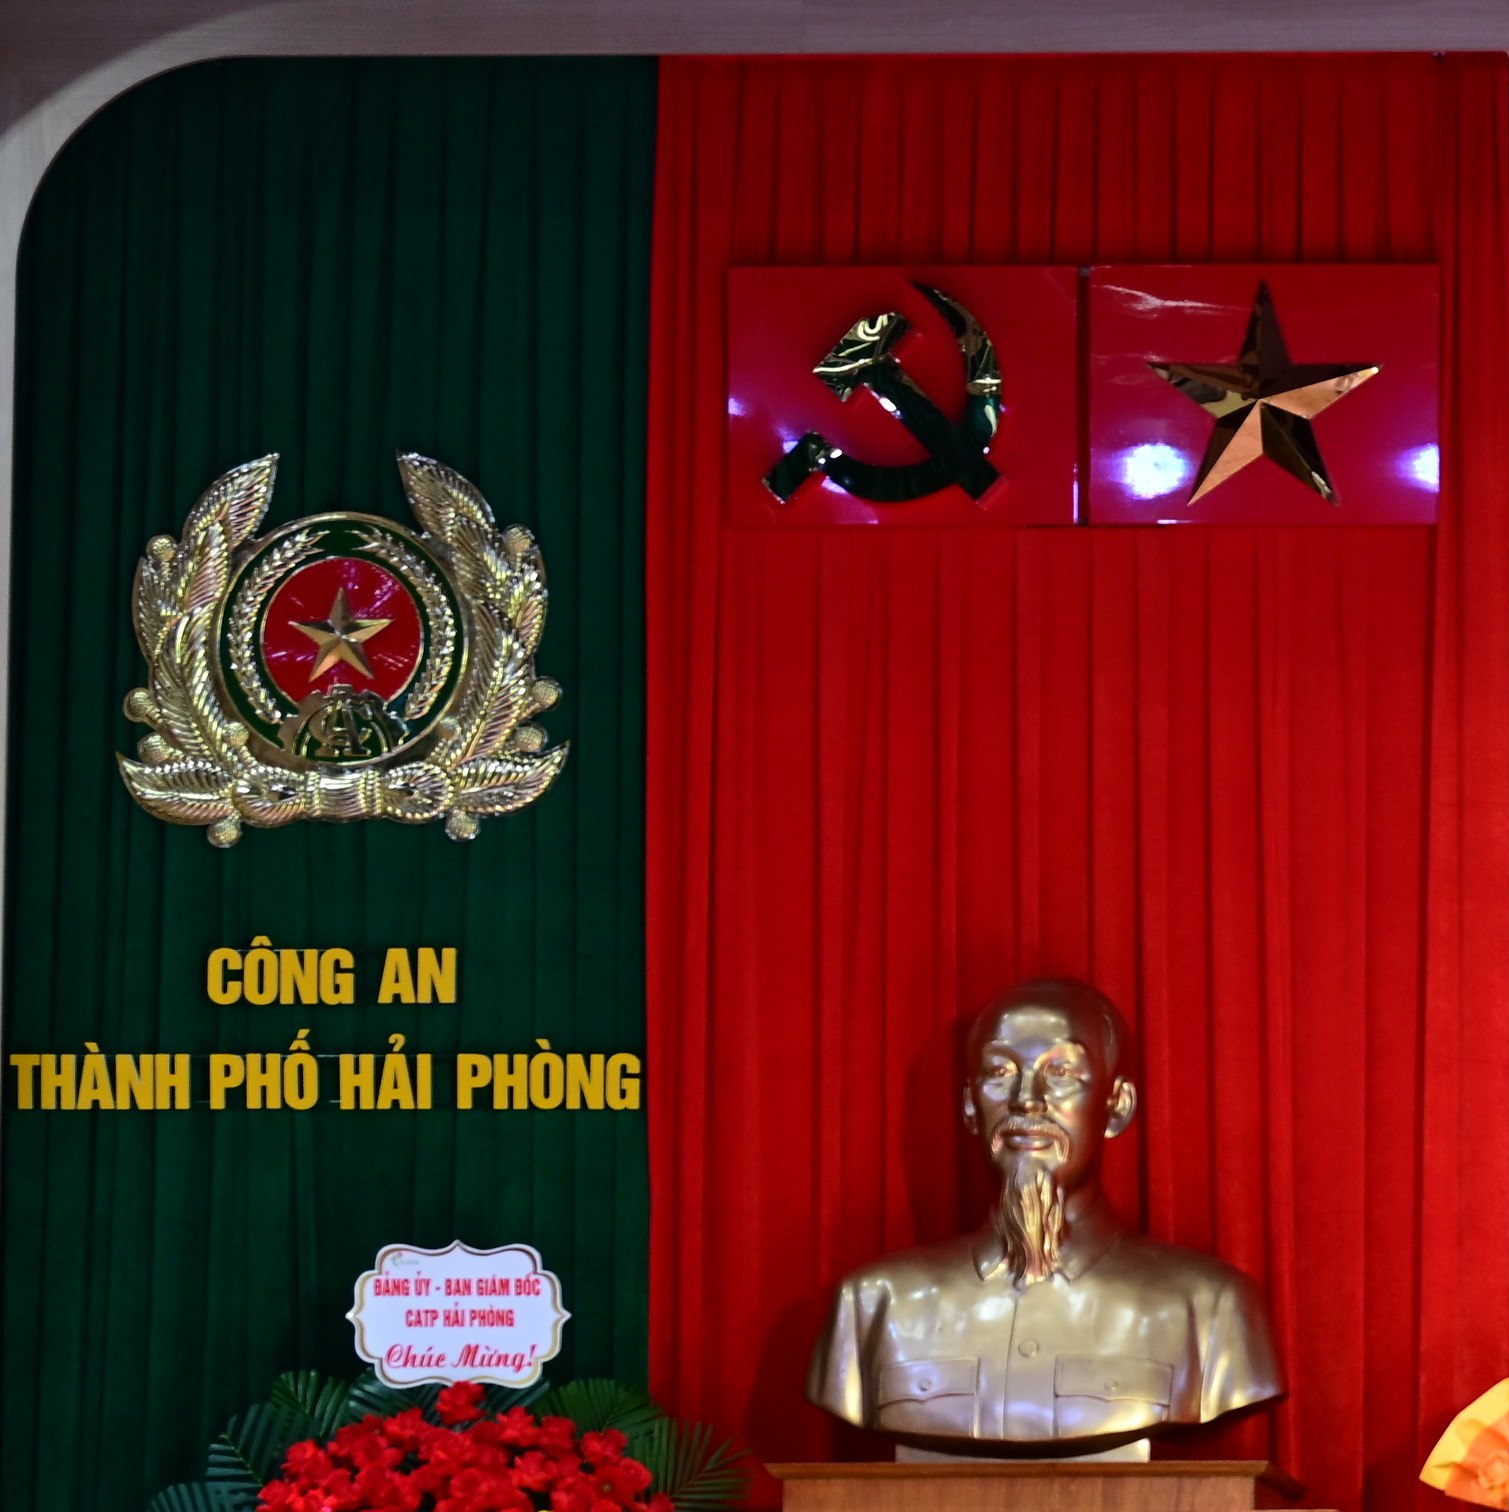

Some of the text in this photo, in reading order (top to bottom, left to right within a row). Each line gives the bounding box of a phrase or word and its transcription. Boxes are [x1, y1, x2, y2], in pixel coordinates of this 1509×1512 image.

[207, 935, 457, 1006] CÔNG AN
[10, 1028, 641, 1110] THÀNH PHỐ HẢI PHÒNG
[374, 1272, 409, 1296] ĐẢNG
[414, 1271, 431, 1296] ỦY
[444, 1278, 471, 1296] BAN
[476, 1274, 510, 1296] GIÁM
[514, 1270, 541, 1296] ĐỐC
[405, 1302, 515, 1327] CATP HẢI PHÒNG
[384, 1344, 537, 1373] Chúc Mừng!
